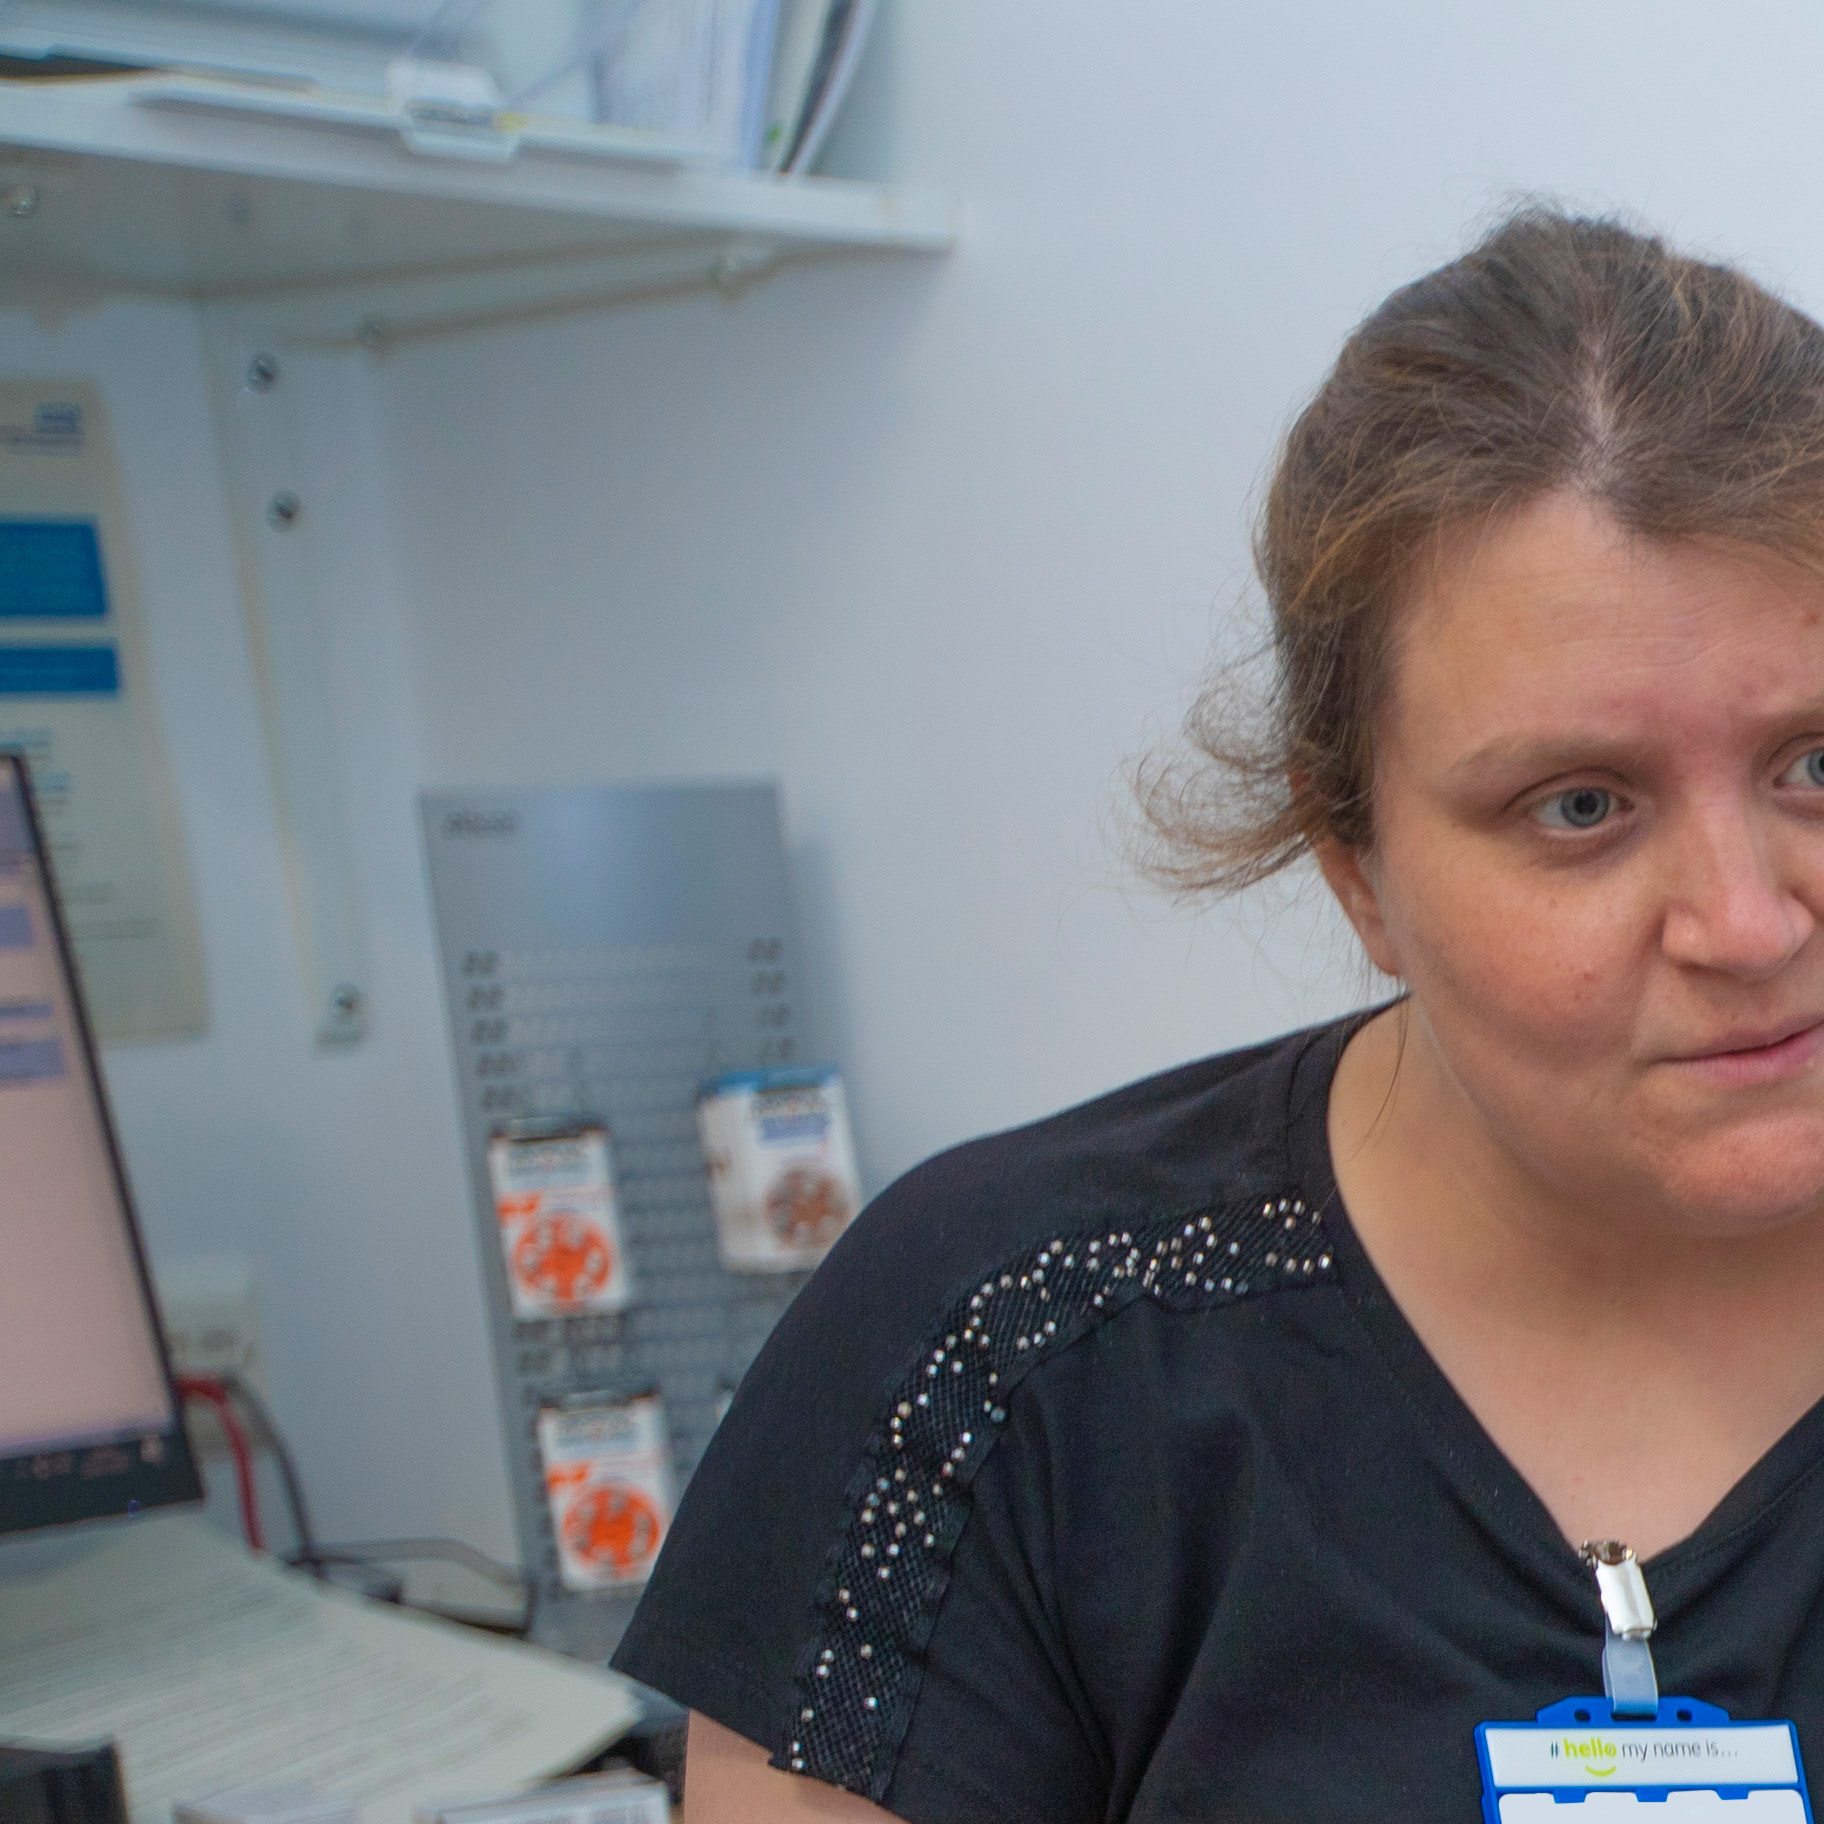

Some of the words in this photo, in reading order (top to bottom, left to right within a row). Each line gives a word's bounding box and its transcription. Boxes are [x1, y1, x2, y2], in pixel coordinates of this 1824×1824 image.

[1563, 1737, 1617, 1758] hello
[1622, 1742, 1648, 1763] my
[1653, 1741, 1701, 1758] name
